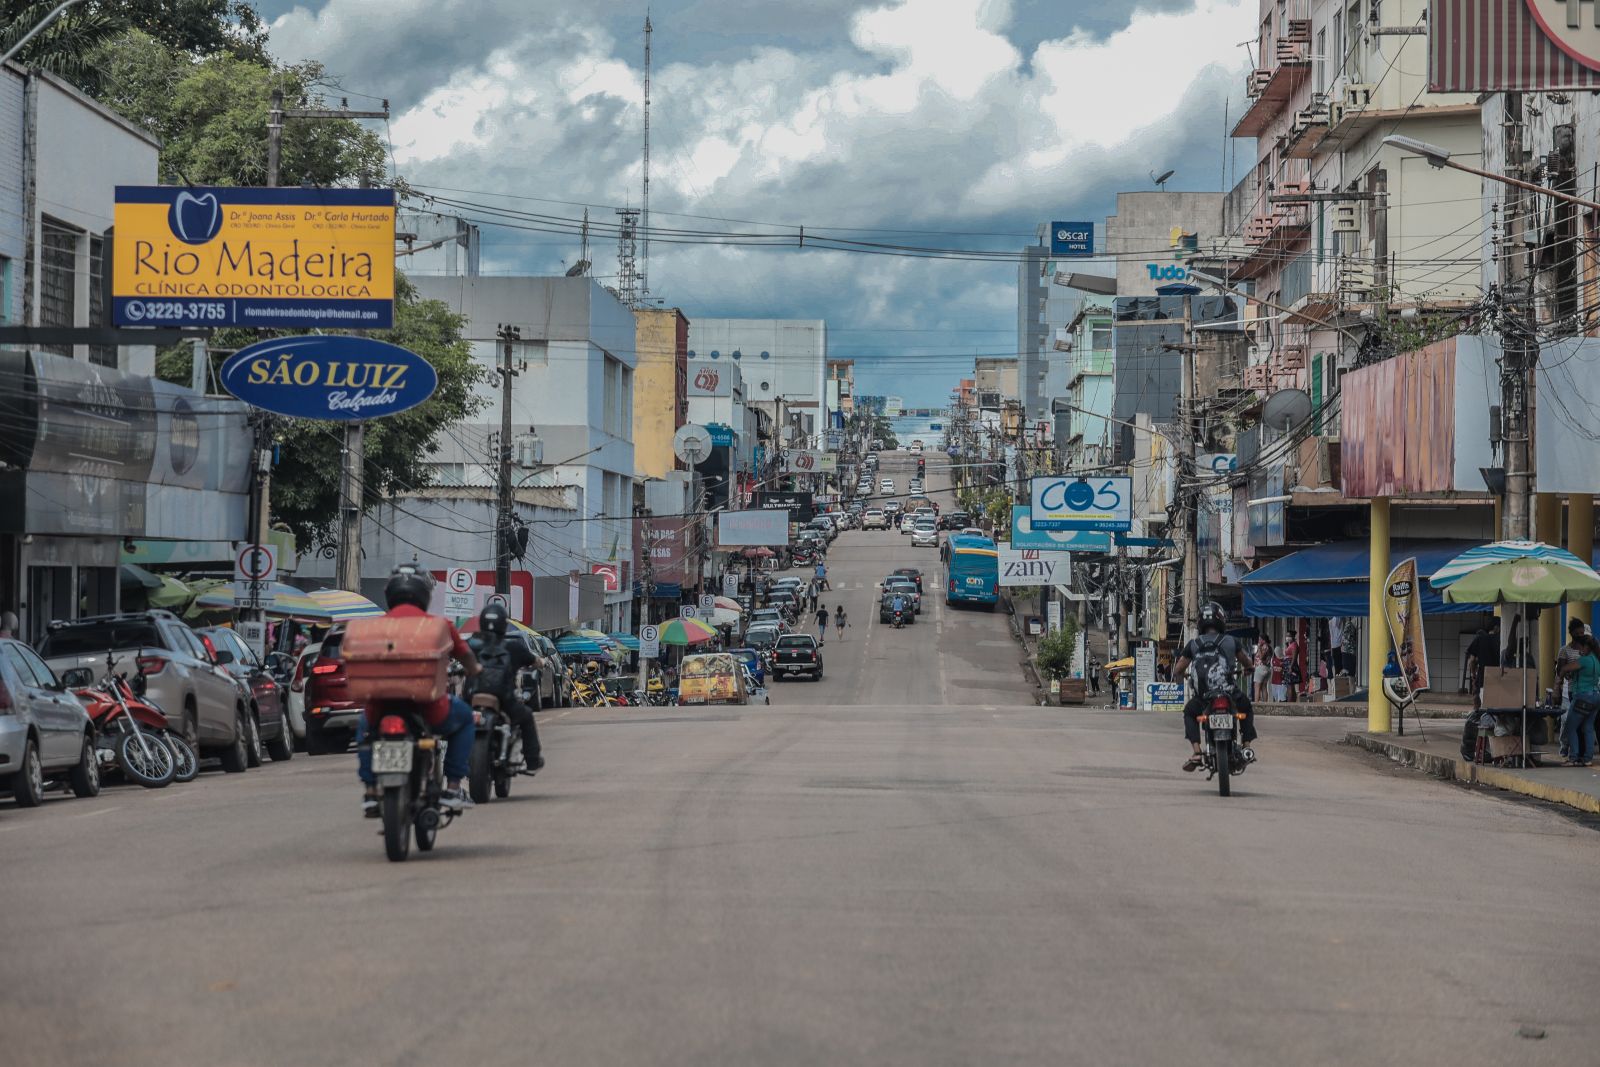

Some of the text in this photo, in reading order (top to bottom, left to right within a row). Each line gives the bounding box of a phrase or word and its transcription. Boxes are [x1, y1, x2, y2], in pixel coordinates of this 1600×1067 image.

[248, 211, 273, 223] Joana
[275, 211, 296, 221] Assis
[324, 211, 349, 221] Carla
[351, 211, 390, 222] Hurtado
[1057, 229, 1089, 240] Oscar
[134, 239, 372, 282] Rio Madeira
[135, 281, 371, 297] CLÍNICA ODONTOLOGICA
[145, 303, 226, 320] 3229-3755
[247, 354, 409, 389] SÃO LUIZ
[327, 388, 398, 412] Calçados
[1003, 560, 1057, 583] zany
[456, 573, 466, 588] E
[728, 577, 734, 585] E
[704, 596, 710, 605] E
[685, 608, 692, 617] E
[646, 628, 654, 639] E
